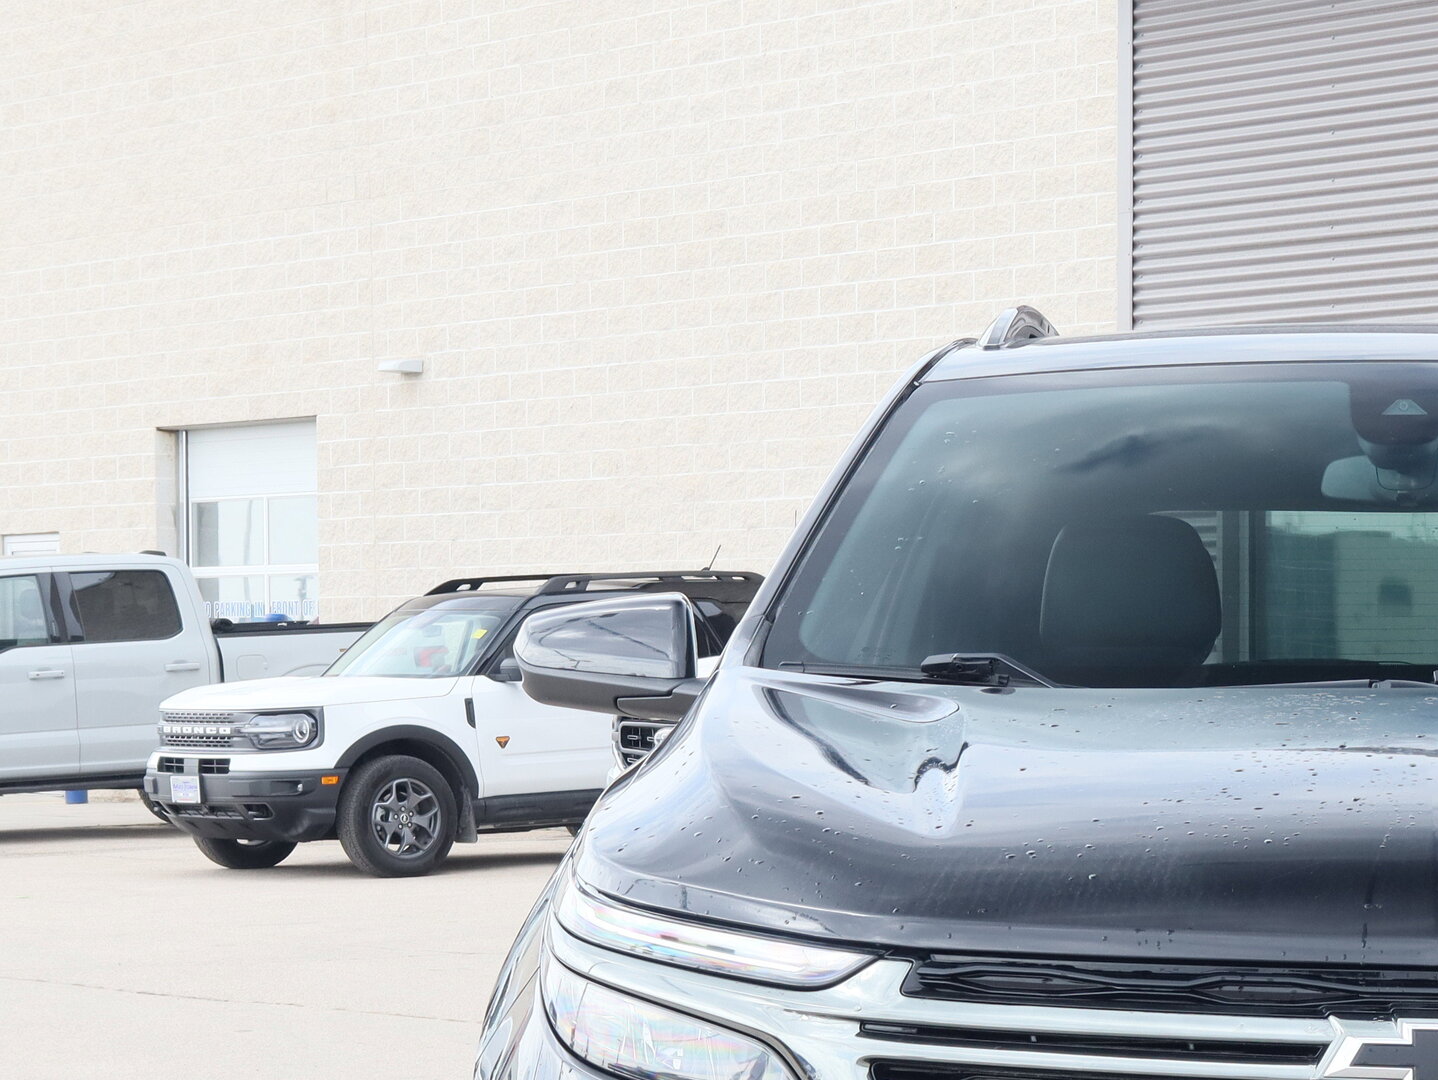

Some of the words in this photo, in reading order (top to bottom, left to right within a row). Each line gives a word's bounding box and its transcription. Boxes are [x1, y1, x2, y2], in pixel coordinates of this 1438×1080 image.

[214, 600, 251, 618] PARKING
[254, 600, 265, 617] IN
[271, 600, 299, 616] FRONT
[302, 599, 314, 616] OF
[163, 725, 231, 735] BRONCO
